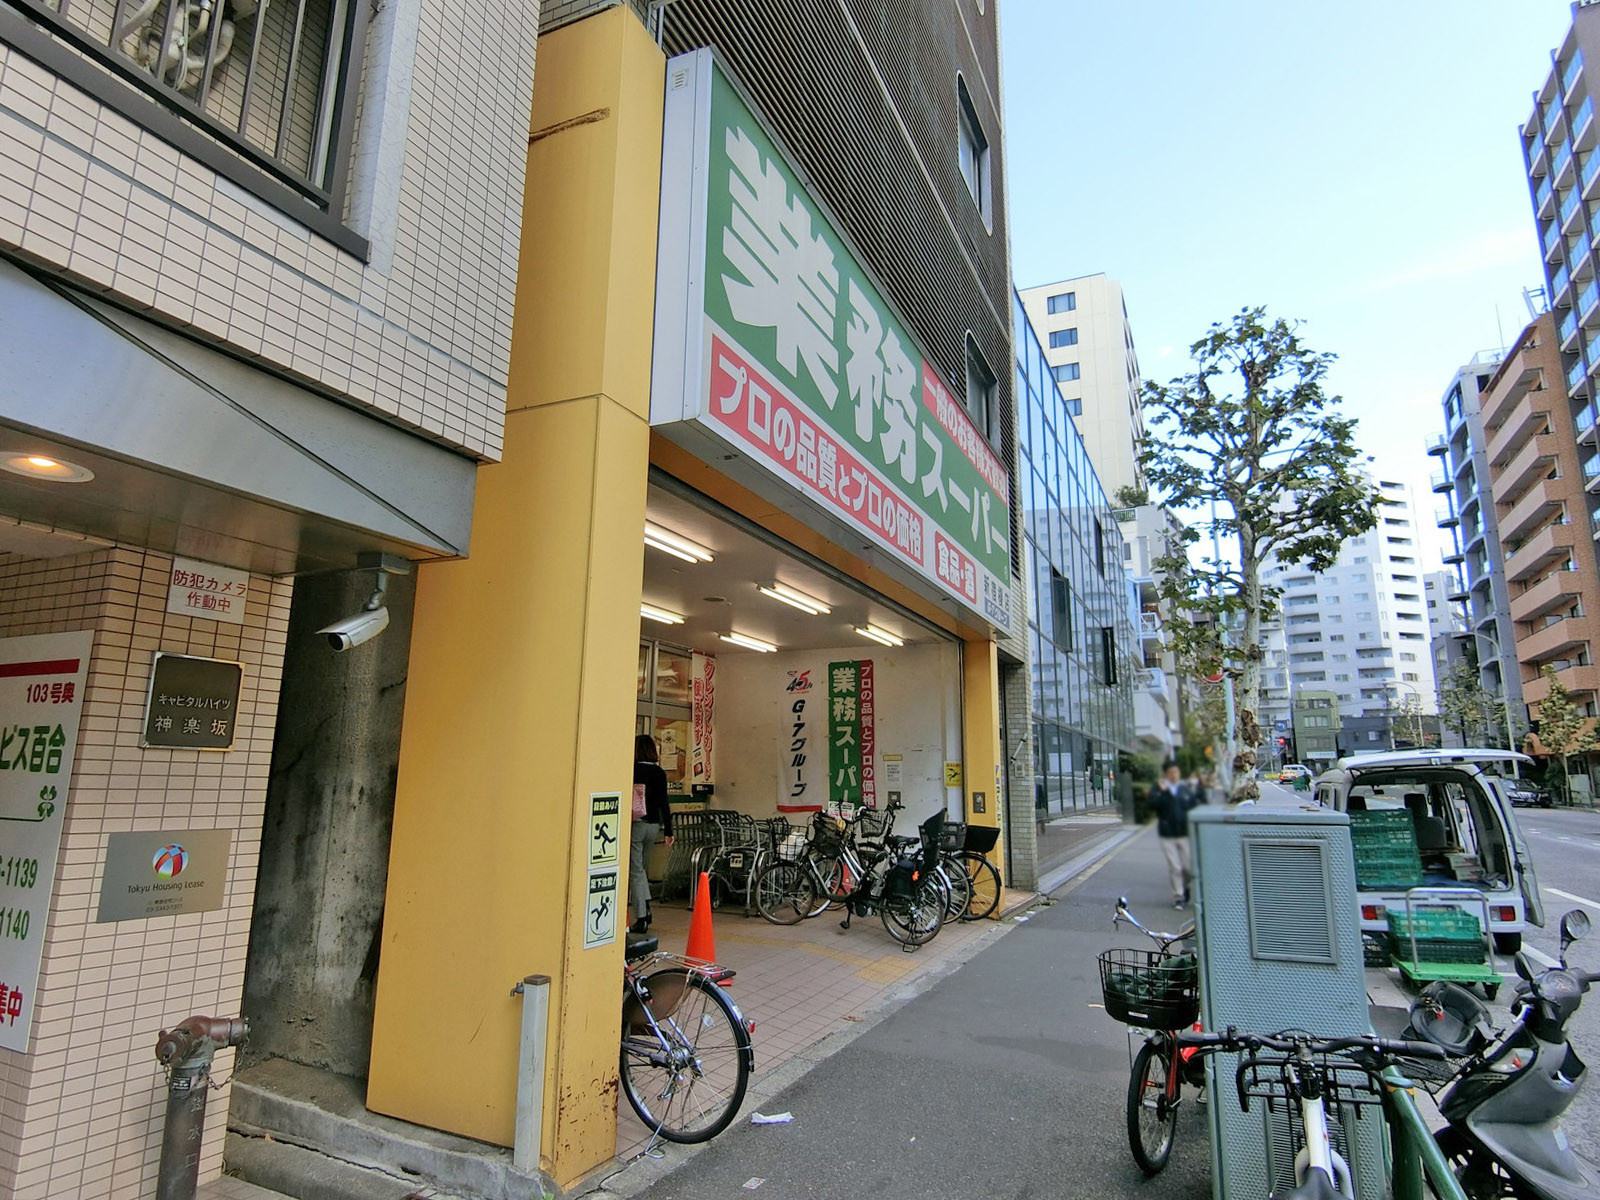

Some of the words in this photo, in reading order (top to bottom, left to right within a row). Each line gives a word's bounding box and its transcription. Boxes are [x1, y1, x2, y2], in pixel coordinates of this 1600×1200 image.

[720, 125, 1007, 555] 業務スーパー
[718, 353, 922, 560] プロの品質とプロの価格
[173, 569, 247, 596] 防犯カメラ
[187, 591, 231, 613] 作動中
[26, 681, 76, 704] 103号奥
[155, 714, 228, 737] 神楽坂
[832, 666, 857, 803] 業務スーパー
[860, 665, 875, 807] プロの品質とプロの価格
[0, 855, 39, 889] -1139
[128, 884, 151, 894] Tokyu
[152, 882, 182, 891] Housing
[184, 880, 205, 889] Lease
